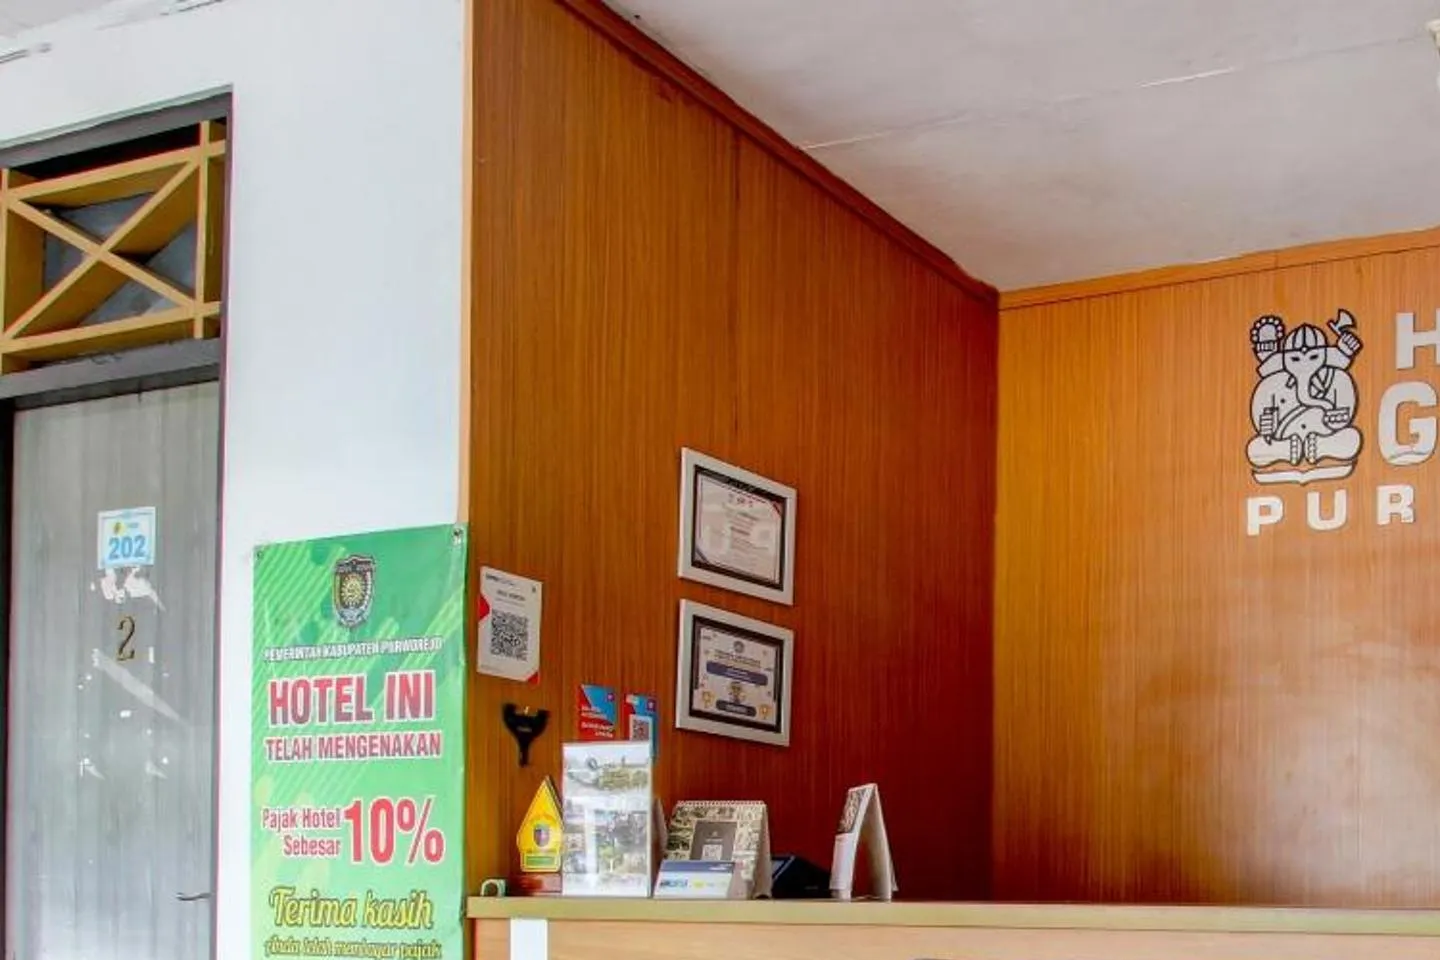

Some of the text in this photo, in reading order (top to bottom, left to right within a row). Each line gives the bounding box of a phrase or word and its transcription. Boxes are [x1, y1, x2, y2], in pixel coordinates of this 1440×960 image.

[108, 534, 146, 560] 202
[116, 615, 135, 661] 2
[324, 641, 379, 658] KABUPATEN
[380, 637, 442, 653] PURWOREJO
[269, 671, 435, 726] HOTEL INI
[265, 732, 441, 761] TELAH MENGENAKAN
[262, 807, 341, 831] Pajak Hotel
[344, 797, 445, 864] 10%
[283, 835, 341, 856] Sebesar
[269, 886, 434, 929] Terima kasih
